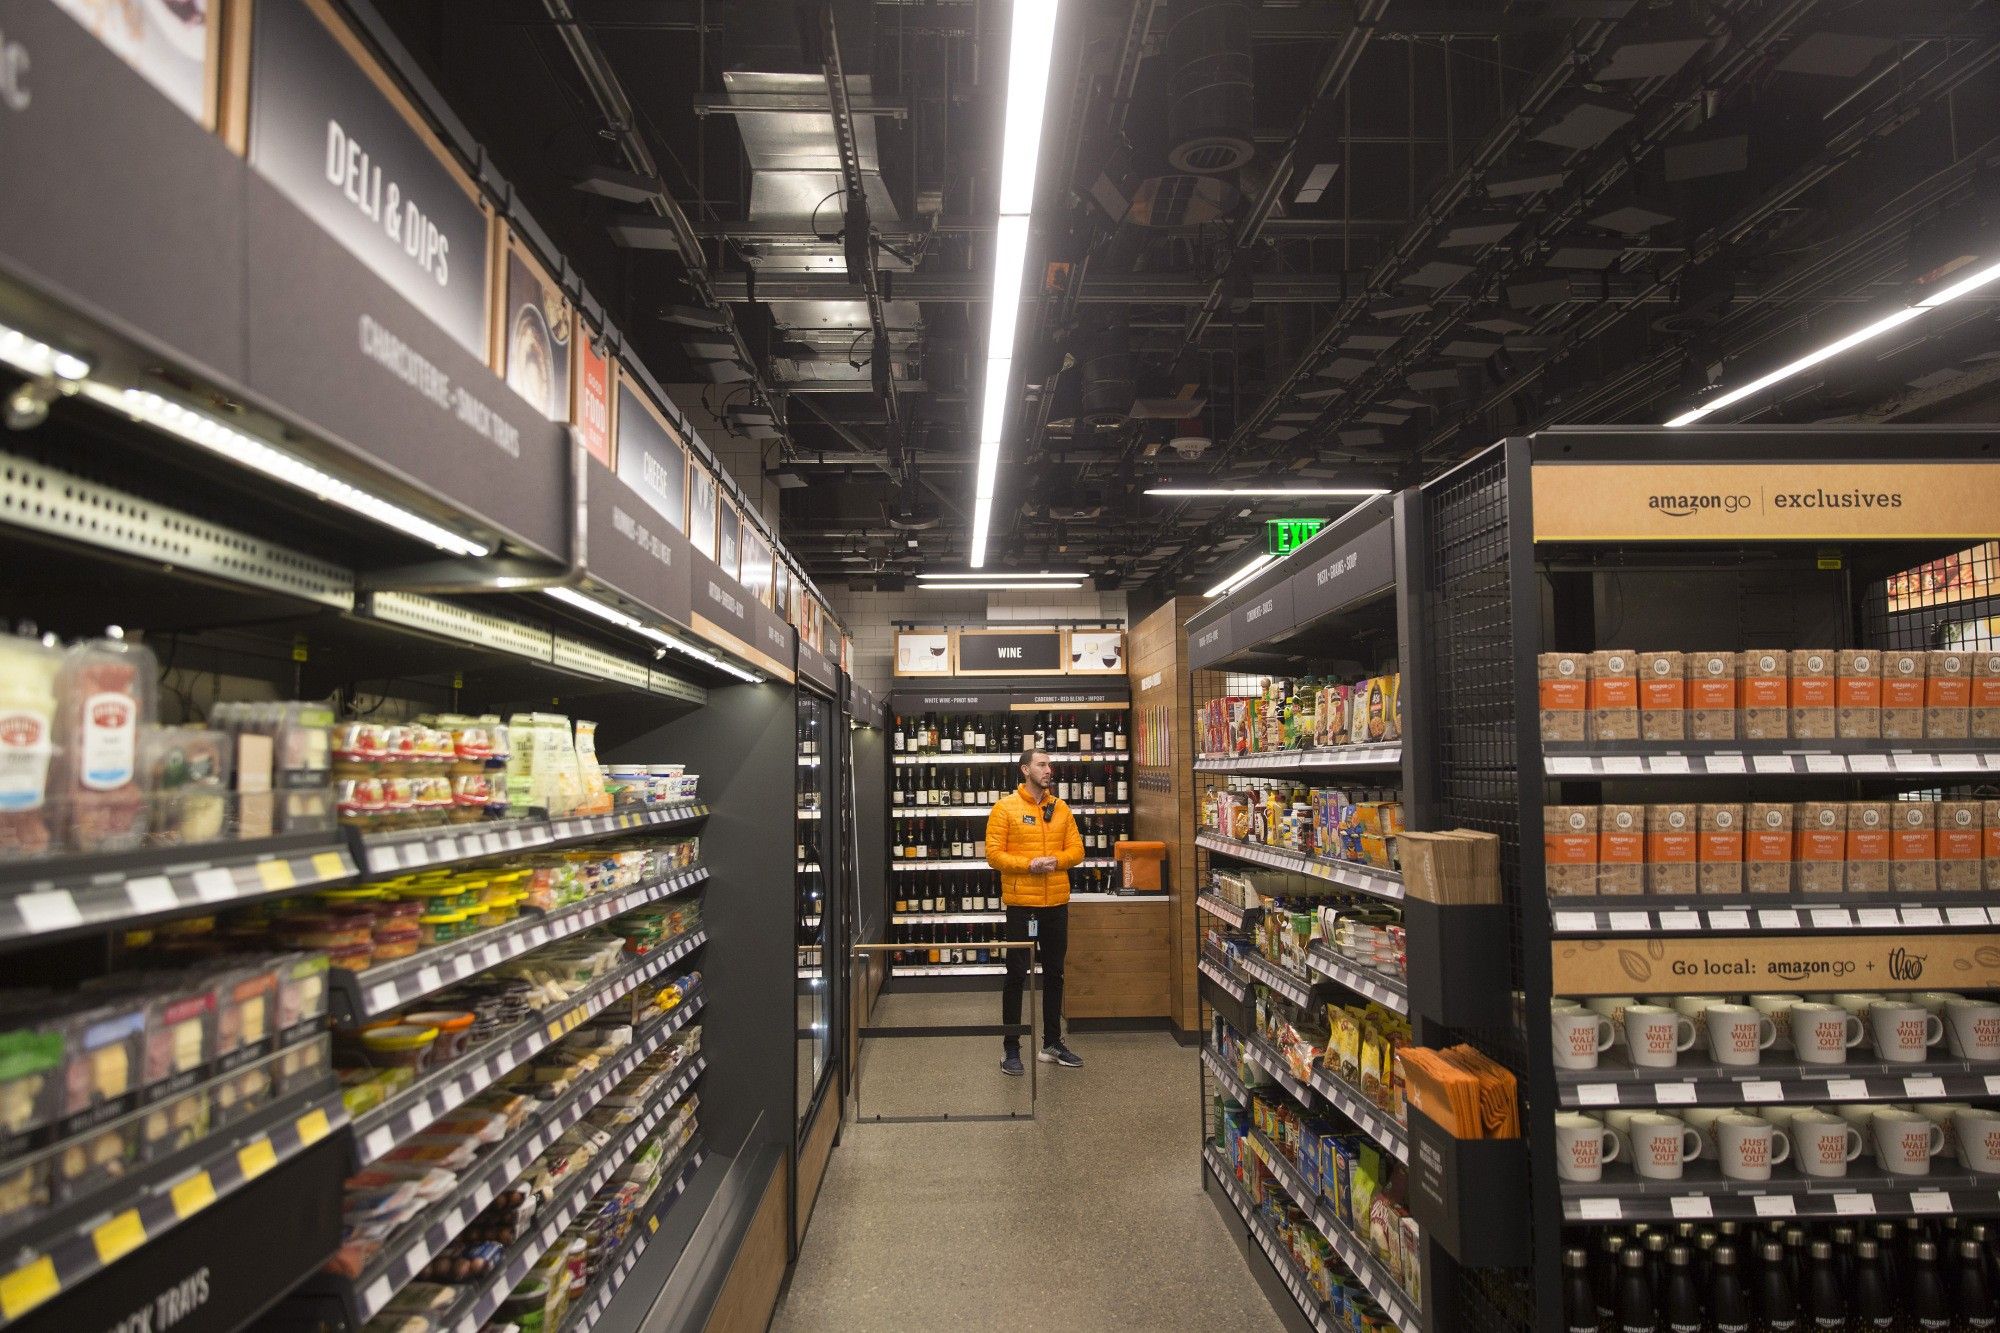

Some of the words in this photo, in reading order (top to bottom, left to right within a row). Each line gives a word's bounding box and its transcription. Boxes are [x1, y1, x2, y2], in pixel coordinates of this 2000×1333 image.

[326, 119, 382, 223] DELI
[385, 182, 402, 244] &
[404, 200, 450, 287] DIPS
[643, 451, 667, 499] CHEESE
[1774, 488, 1903, 509] exclusives
[1317, 569, 1328, 586] PASTA
[997, 647, 1023, 659] WINE
[1672, 960, 1698, 976] Go
[1704, 958, 1757, 975] local:
[1648, 1025, 1673, 1033] JUST
[1733, 1024, 1758, 1032] JUST
[1818, 1022, 1842, 1030] JUST
[1645, 1033, 1673, 1041] WALK
[1731, 1032, 1759, 1040] WALK
[1815, 1030, 1844, 1038] WALK
[1569, 1036, 1597, 1044] WALK
[1819, 1038, 1841, 1046] OUT
[1978, 1035, 1999, 1043] OUT
[1573, 1044, 1593, 1052] OUT
[1649, 1041, 1671, 1049] OUT
[1735, 1040, 1756, 1048] OUT
[1653, 1137, 1677, 1145] JUST
[1743, 1138, 1768, 1146] JUST
[1572, 1148, 1599, 1156] WALK
[1650, 1145, 1679, 1153] WALK
[1739, 1146, 1769, 1154] WALK
[1817, 1144, 1845, 1152] WALK
[1654, 1153, 1675, 1161] OUT
[1822, 1152, 1843, 1160] OUT
[1906, 1150, 1927, 1158] OUT
[1576, 1156, 1596, 1164] OUT
[156, 1266, 210, 1332] TRAYS
[1623, 1325, 1648, 1333] amazon
[1671, 1324, 1696, 1332] amazon
[1718, 1323, 1743, 1331] amazon
